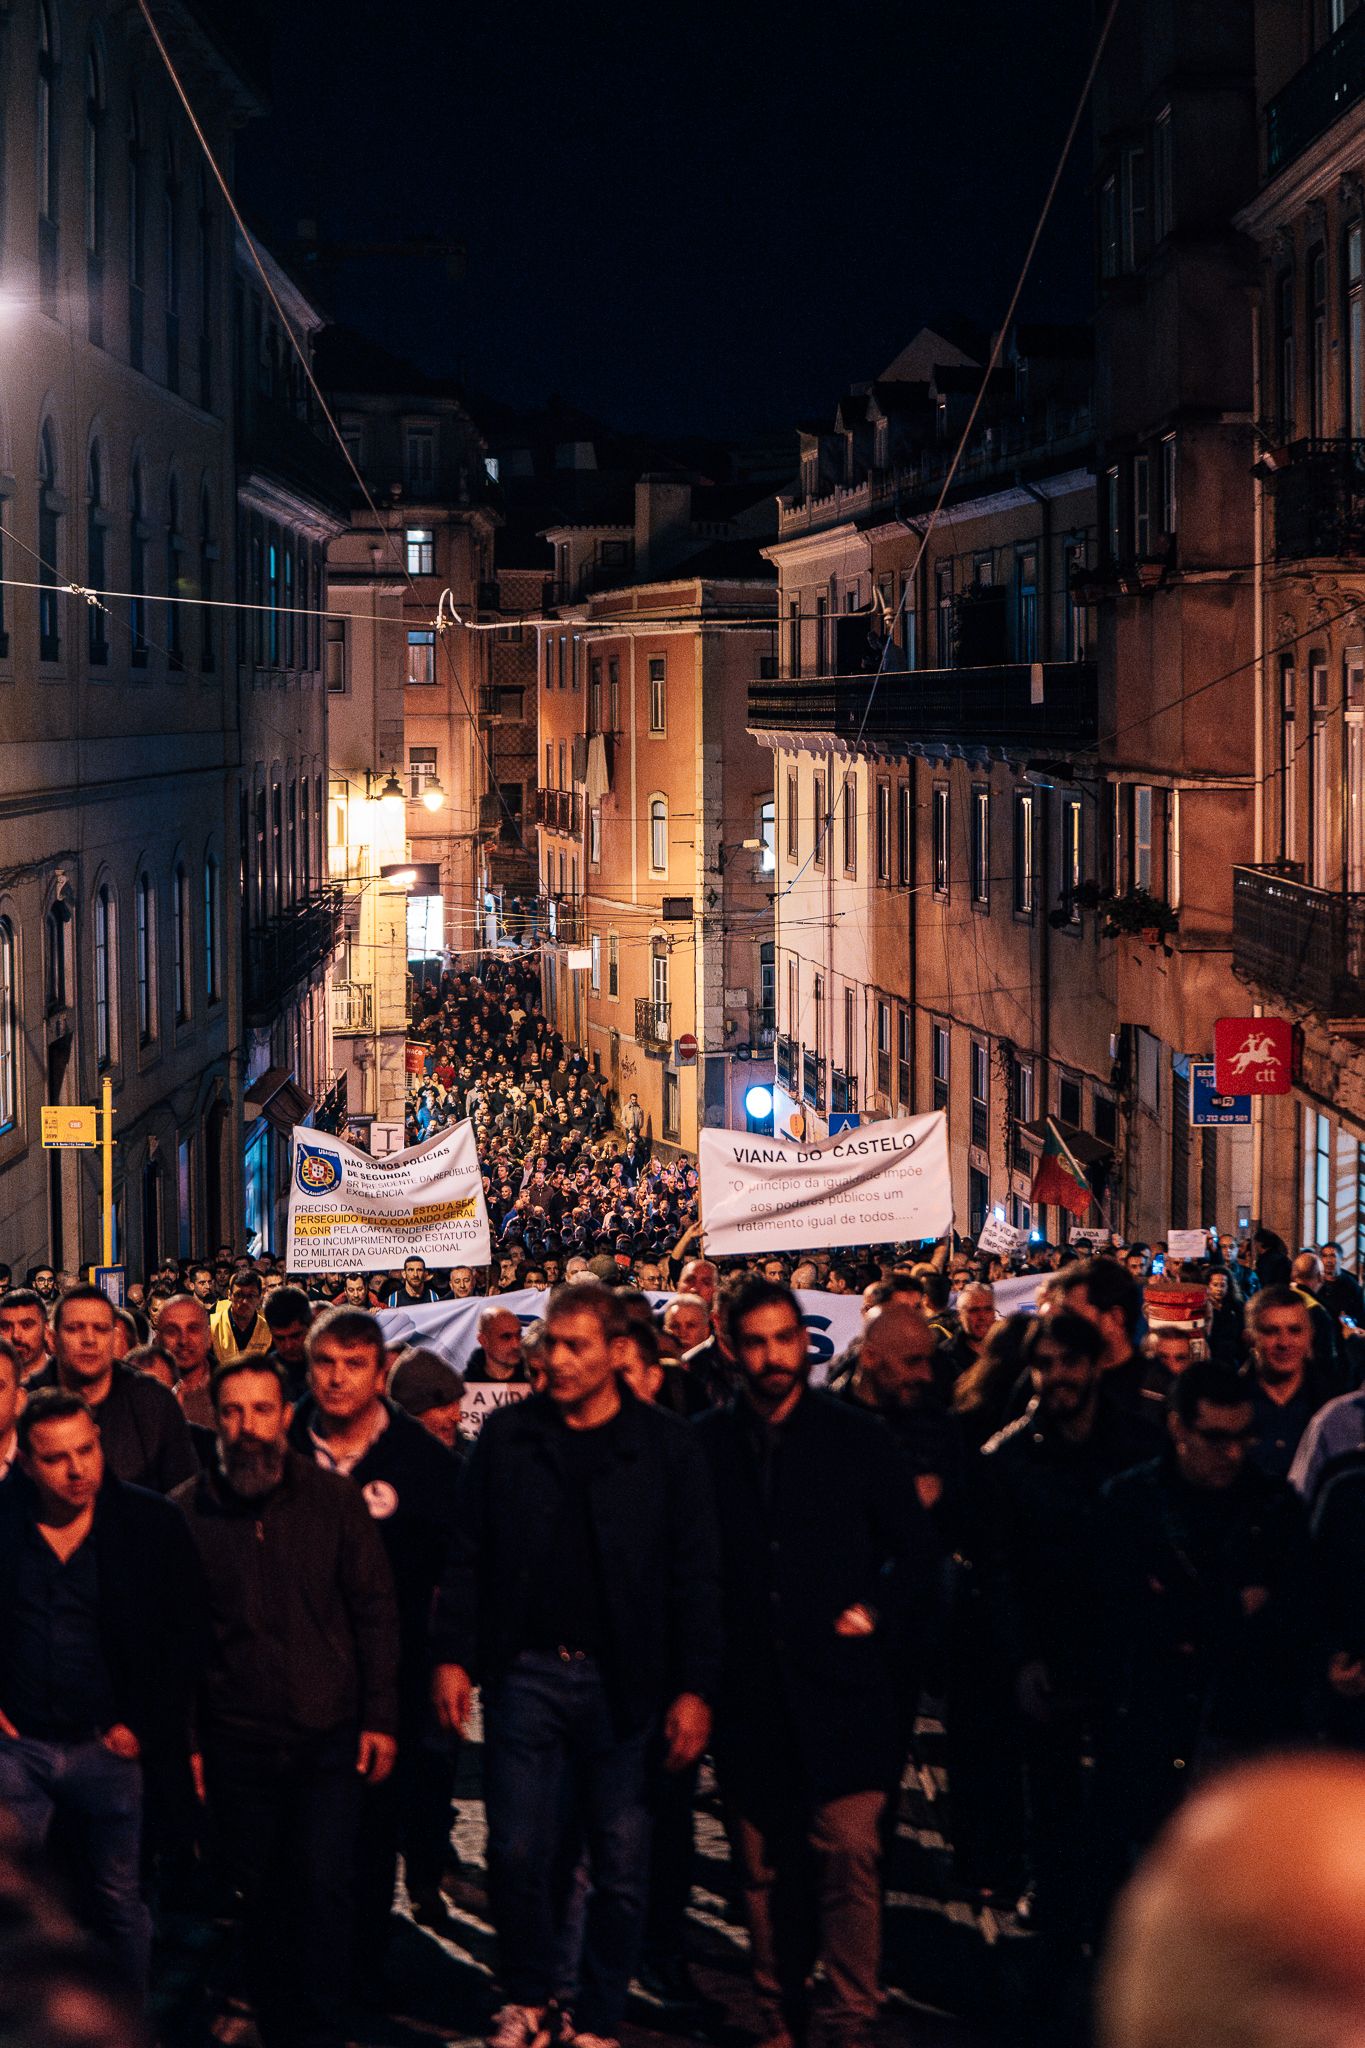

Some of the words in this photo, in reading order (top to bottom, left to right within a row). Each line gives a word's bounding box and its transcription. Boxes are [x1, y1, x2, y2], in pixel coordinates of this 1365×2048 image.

[1256, 1069, 1276, 1082] ctt
[733, 1147, 787, 1163] VIANA
[797, 1149, 822, 1163] DO
[832, 1134, 916, 1158] CASTELO
[344, 1159, 363, 1169] NÃO
[365, 1161, 401, 1170] SOMOS
[346, 1180, 360, 1189] SR
[361, 1178, 418, 1190] PRESIDENTE
[419, 1175, 432, 1183] DA
[433, 1164, 481, 1181] REPÚBLICA
[347, 1169, 359, 1178] DE
[360, 1171, 411, 1181] SEGUNDA!
[804, 1177, 820, 1189] da
[294, 1203, 338, 1213] PRECISO
[340, 1204, 354, 1213] DA
[356, 1207, 377, 1216] SUA
[377, 1209, 411, 1217] AJUDA
[413, 1203, 445, 1216] ESTOU
[447, 1202, 454, 1210] A
[455, 1198, 475, 1208] SER
[751, 1202, 773, 1212] aos
[884, 1190, 903, 1201] um
[294, 1215, 359, 1224] PERSEGUIDO
[361, 1216, 388, 1225] PELO
[390, 1213, 440, 1226] COMANDO
[442, 1209, 476, 1220] GERAL
[737, 1216, 804, 1232] tratamento
[807, 1215, 837, 1232] igual
[840, 1213, 856, 1224] de
[294, 1227, 308, 1235] DA
[309, 1226, 331, 1235] GNR
[333, 1225, 359, 1234] PELA
[360, 1225, 393, 1234] CARTA
[395, 1220, 463, 1235] ENDEREÇADA
[463, 1220, 471, 1228] A
[472, 1219, 482, 1228] SI
[1000, 1224, 1018, 1239] VIDA
[293, 1237, 320, 1246] PELO
[323, 1235, 405, 1245] INCUMPRIMENTO
[407, 1235, 422, 1243] DO
[425, 1231, 477, 1242] ESTATUTO
[293, 1248, 308, 1257] DO
[311, 1247, 349, 1257] MILITAR
[352, 1247, 365, 1256] DA
[367, 1246, 409, 1255] GUARDA
[410, 1243, 461, 1254] NACIONAL
[473, 1391, 486, 1405] A
[492, 1391, 533, 1407] VID
